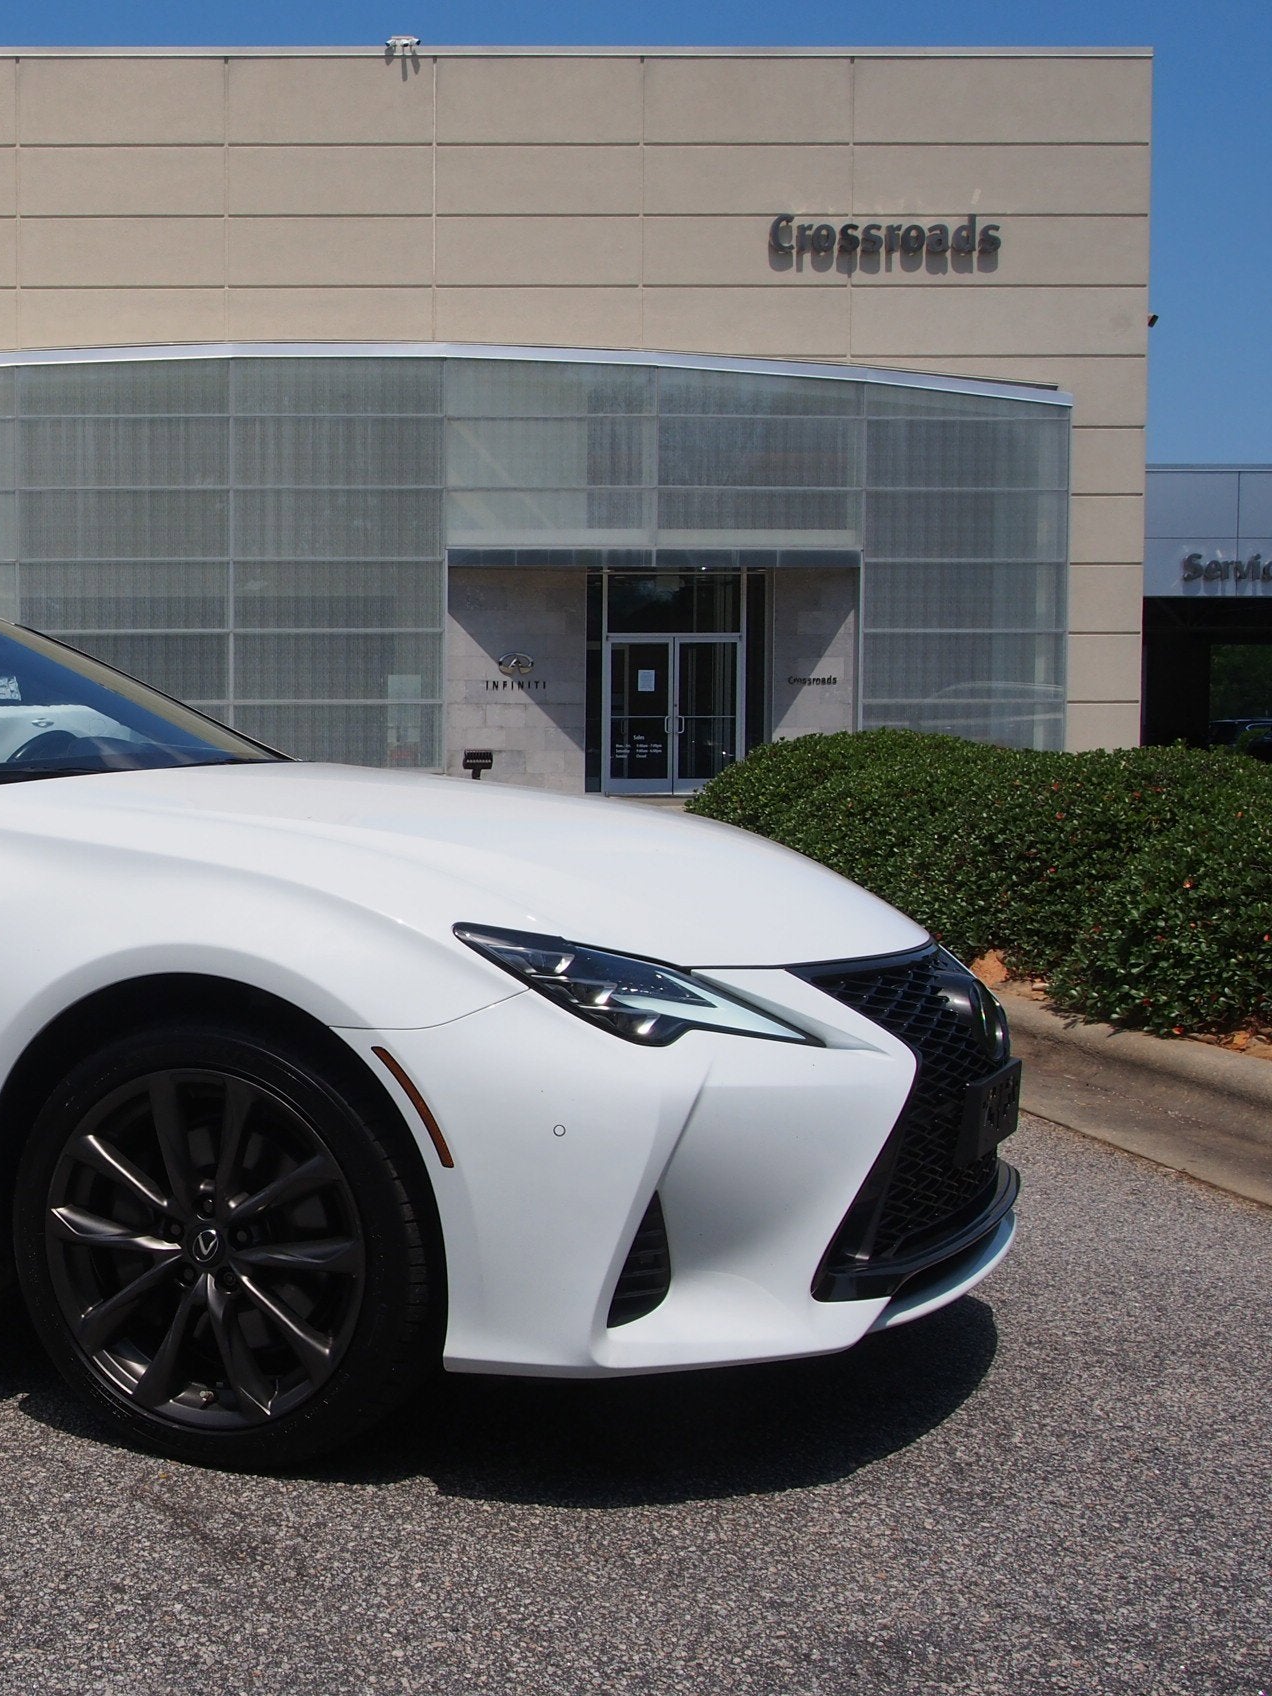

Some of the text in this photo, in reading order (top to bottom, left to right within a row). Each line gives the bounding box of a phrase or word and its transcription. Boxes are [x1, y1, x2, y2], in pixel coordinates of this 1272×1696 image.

[769, 213, 1002, 256] Crossroads
[485, 680, 546, 690] INFINITI
[788, 675, 837, 686] Crossroads
